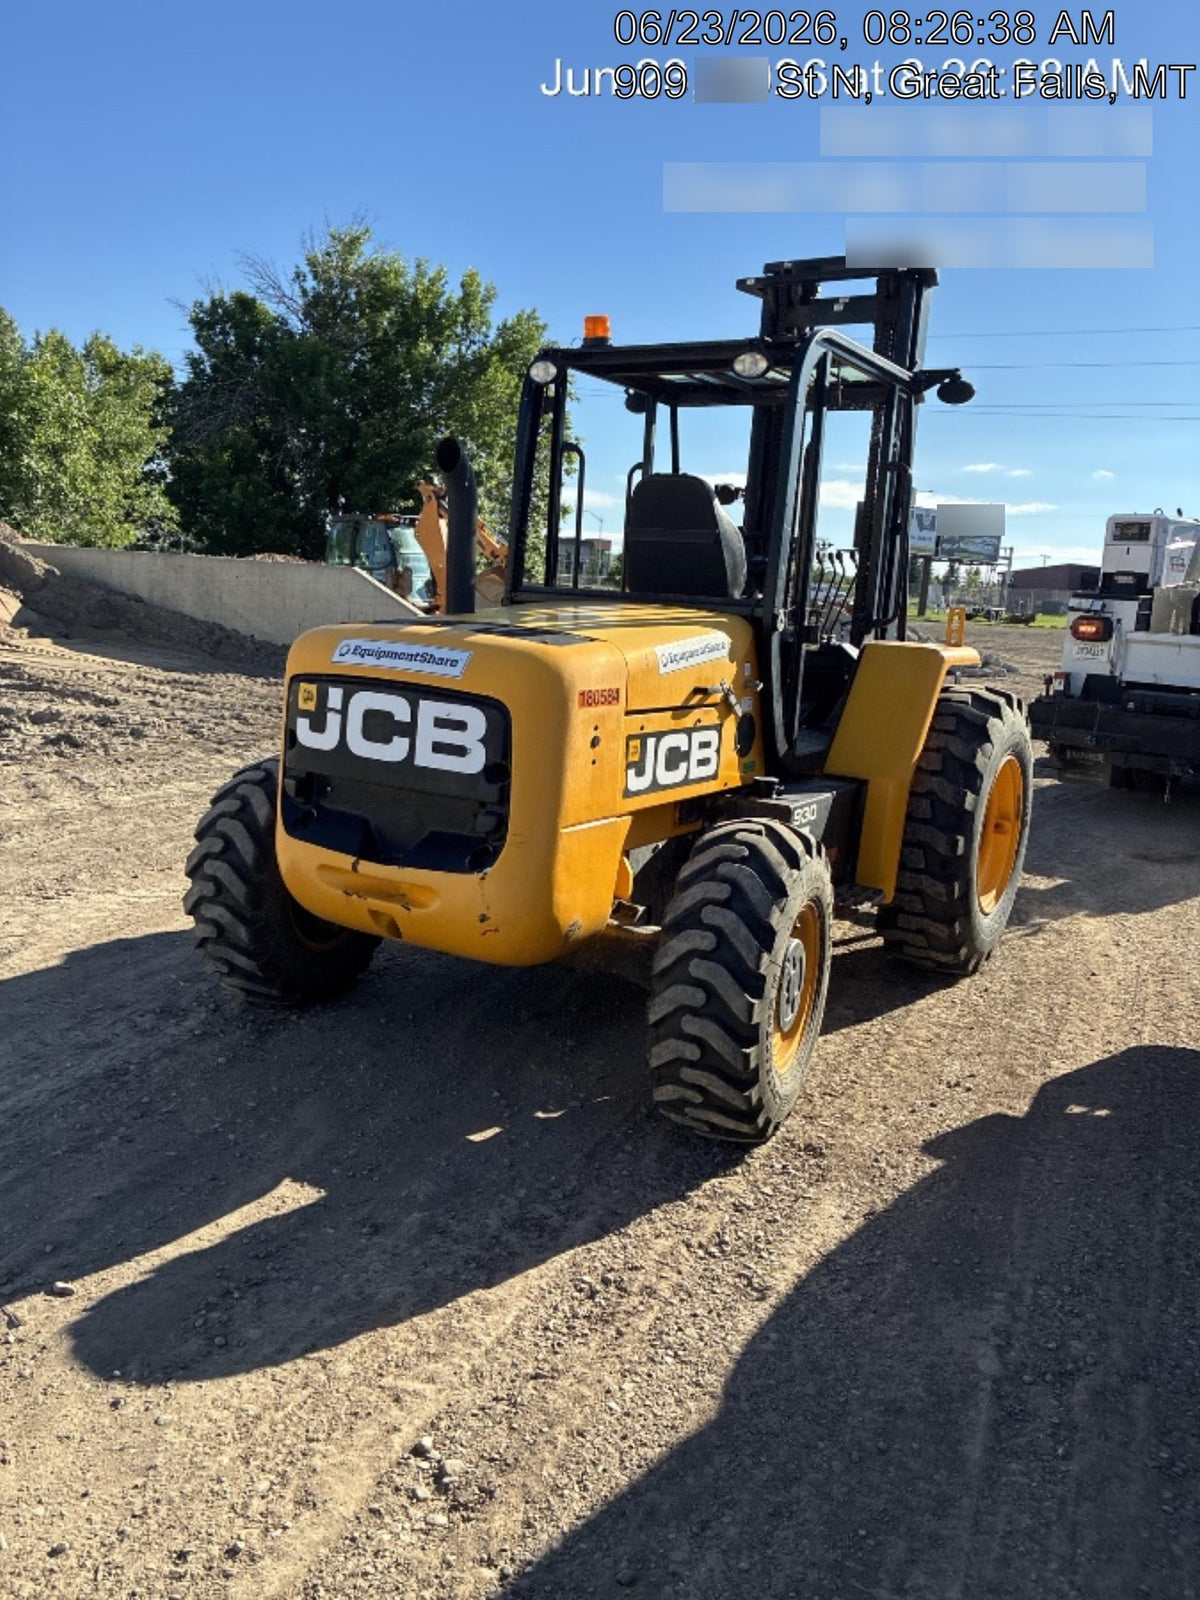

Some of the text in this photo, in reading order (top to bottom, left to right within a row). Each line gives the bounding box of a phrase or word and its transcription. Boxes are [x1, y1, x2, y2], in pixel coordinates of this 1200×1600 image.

[351, 644, 459, 668] EquipmentShare
[579, 688, 621, 708] 180584
[296, 686, 487, 774] JCB
[626, 729, 719, 792] JCB
[792, 803, 817, 826] 930
